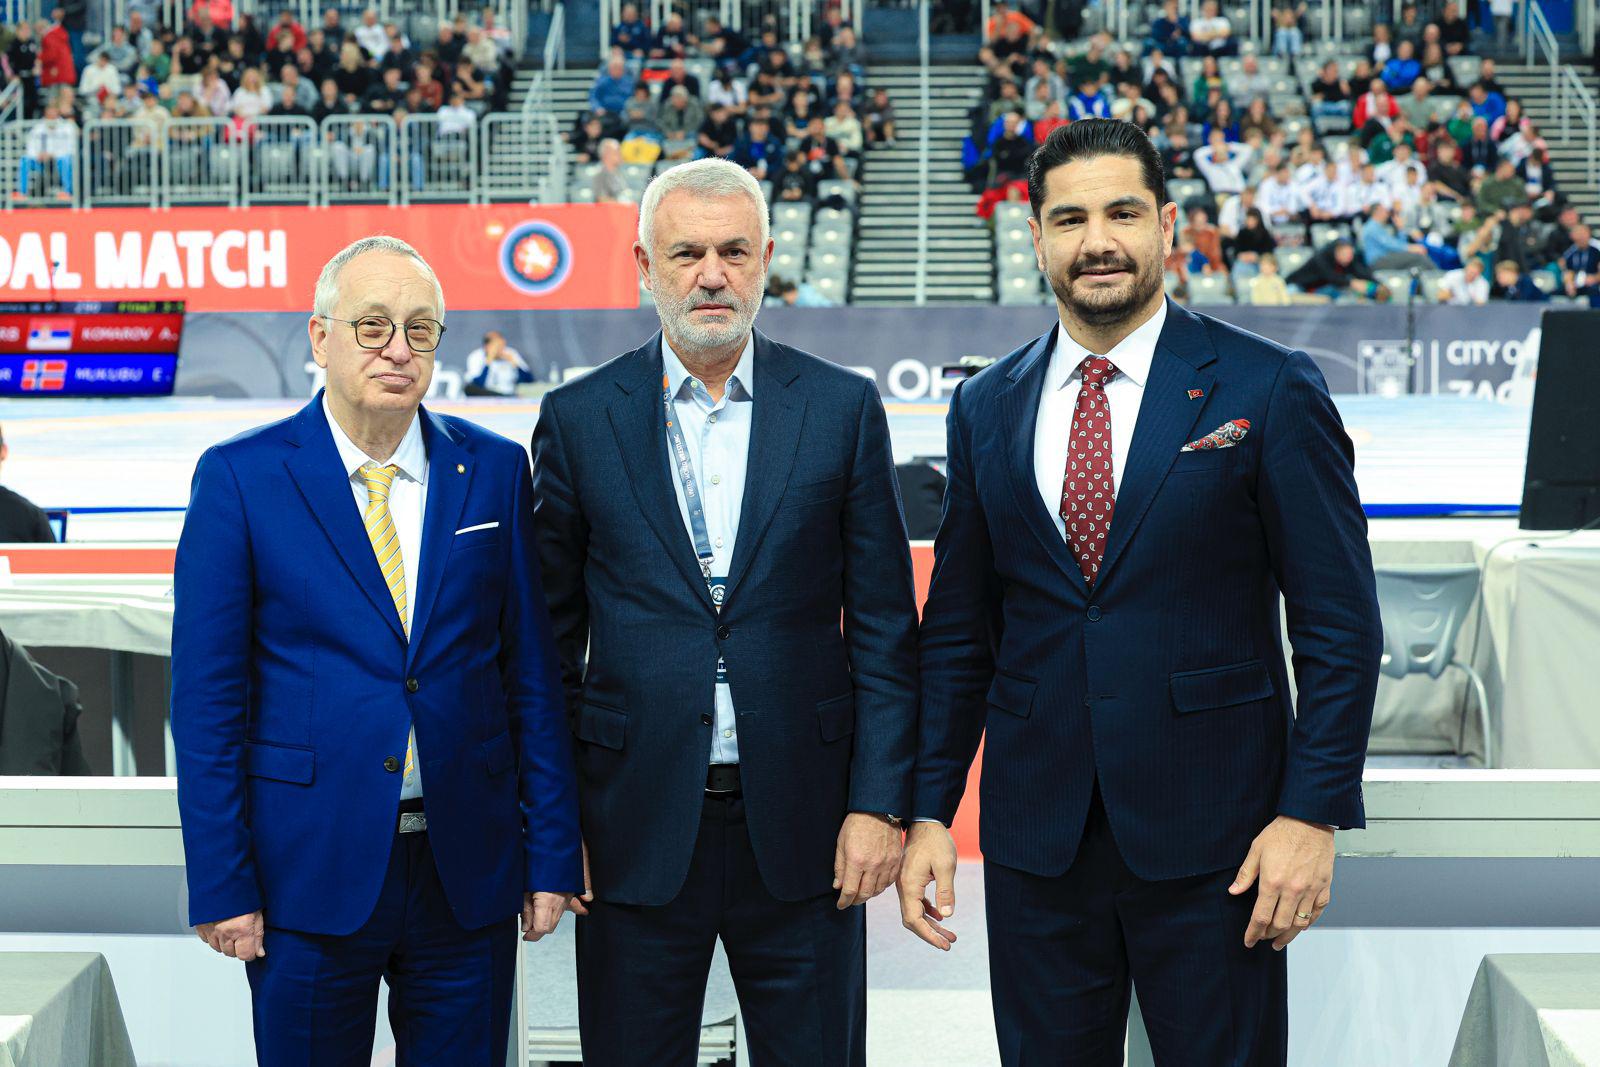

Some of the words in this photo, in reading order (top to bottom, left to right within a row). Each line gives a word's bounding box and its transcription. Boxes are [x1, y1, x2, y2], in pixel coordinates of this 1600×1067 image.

[94, 229, 287, 289] MATCH
[81, 327, 152, 342] KOMAROV
[1446, 340, 1500, 366] CITY
[1502, 340, 1522, 366] O
